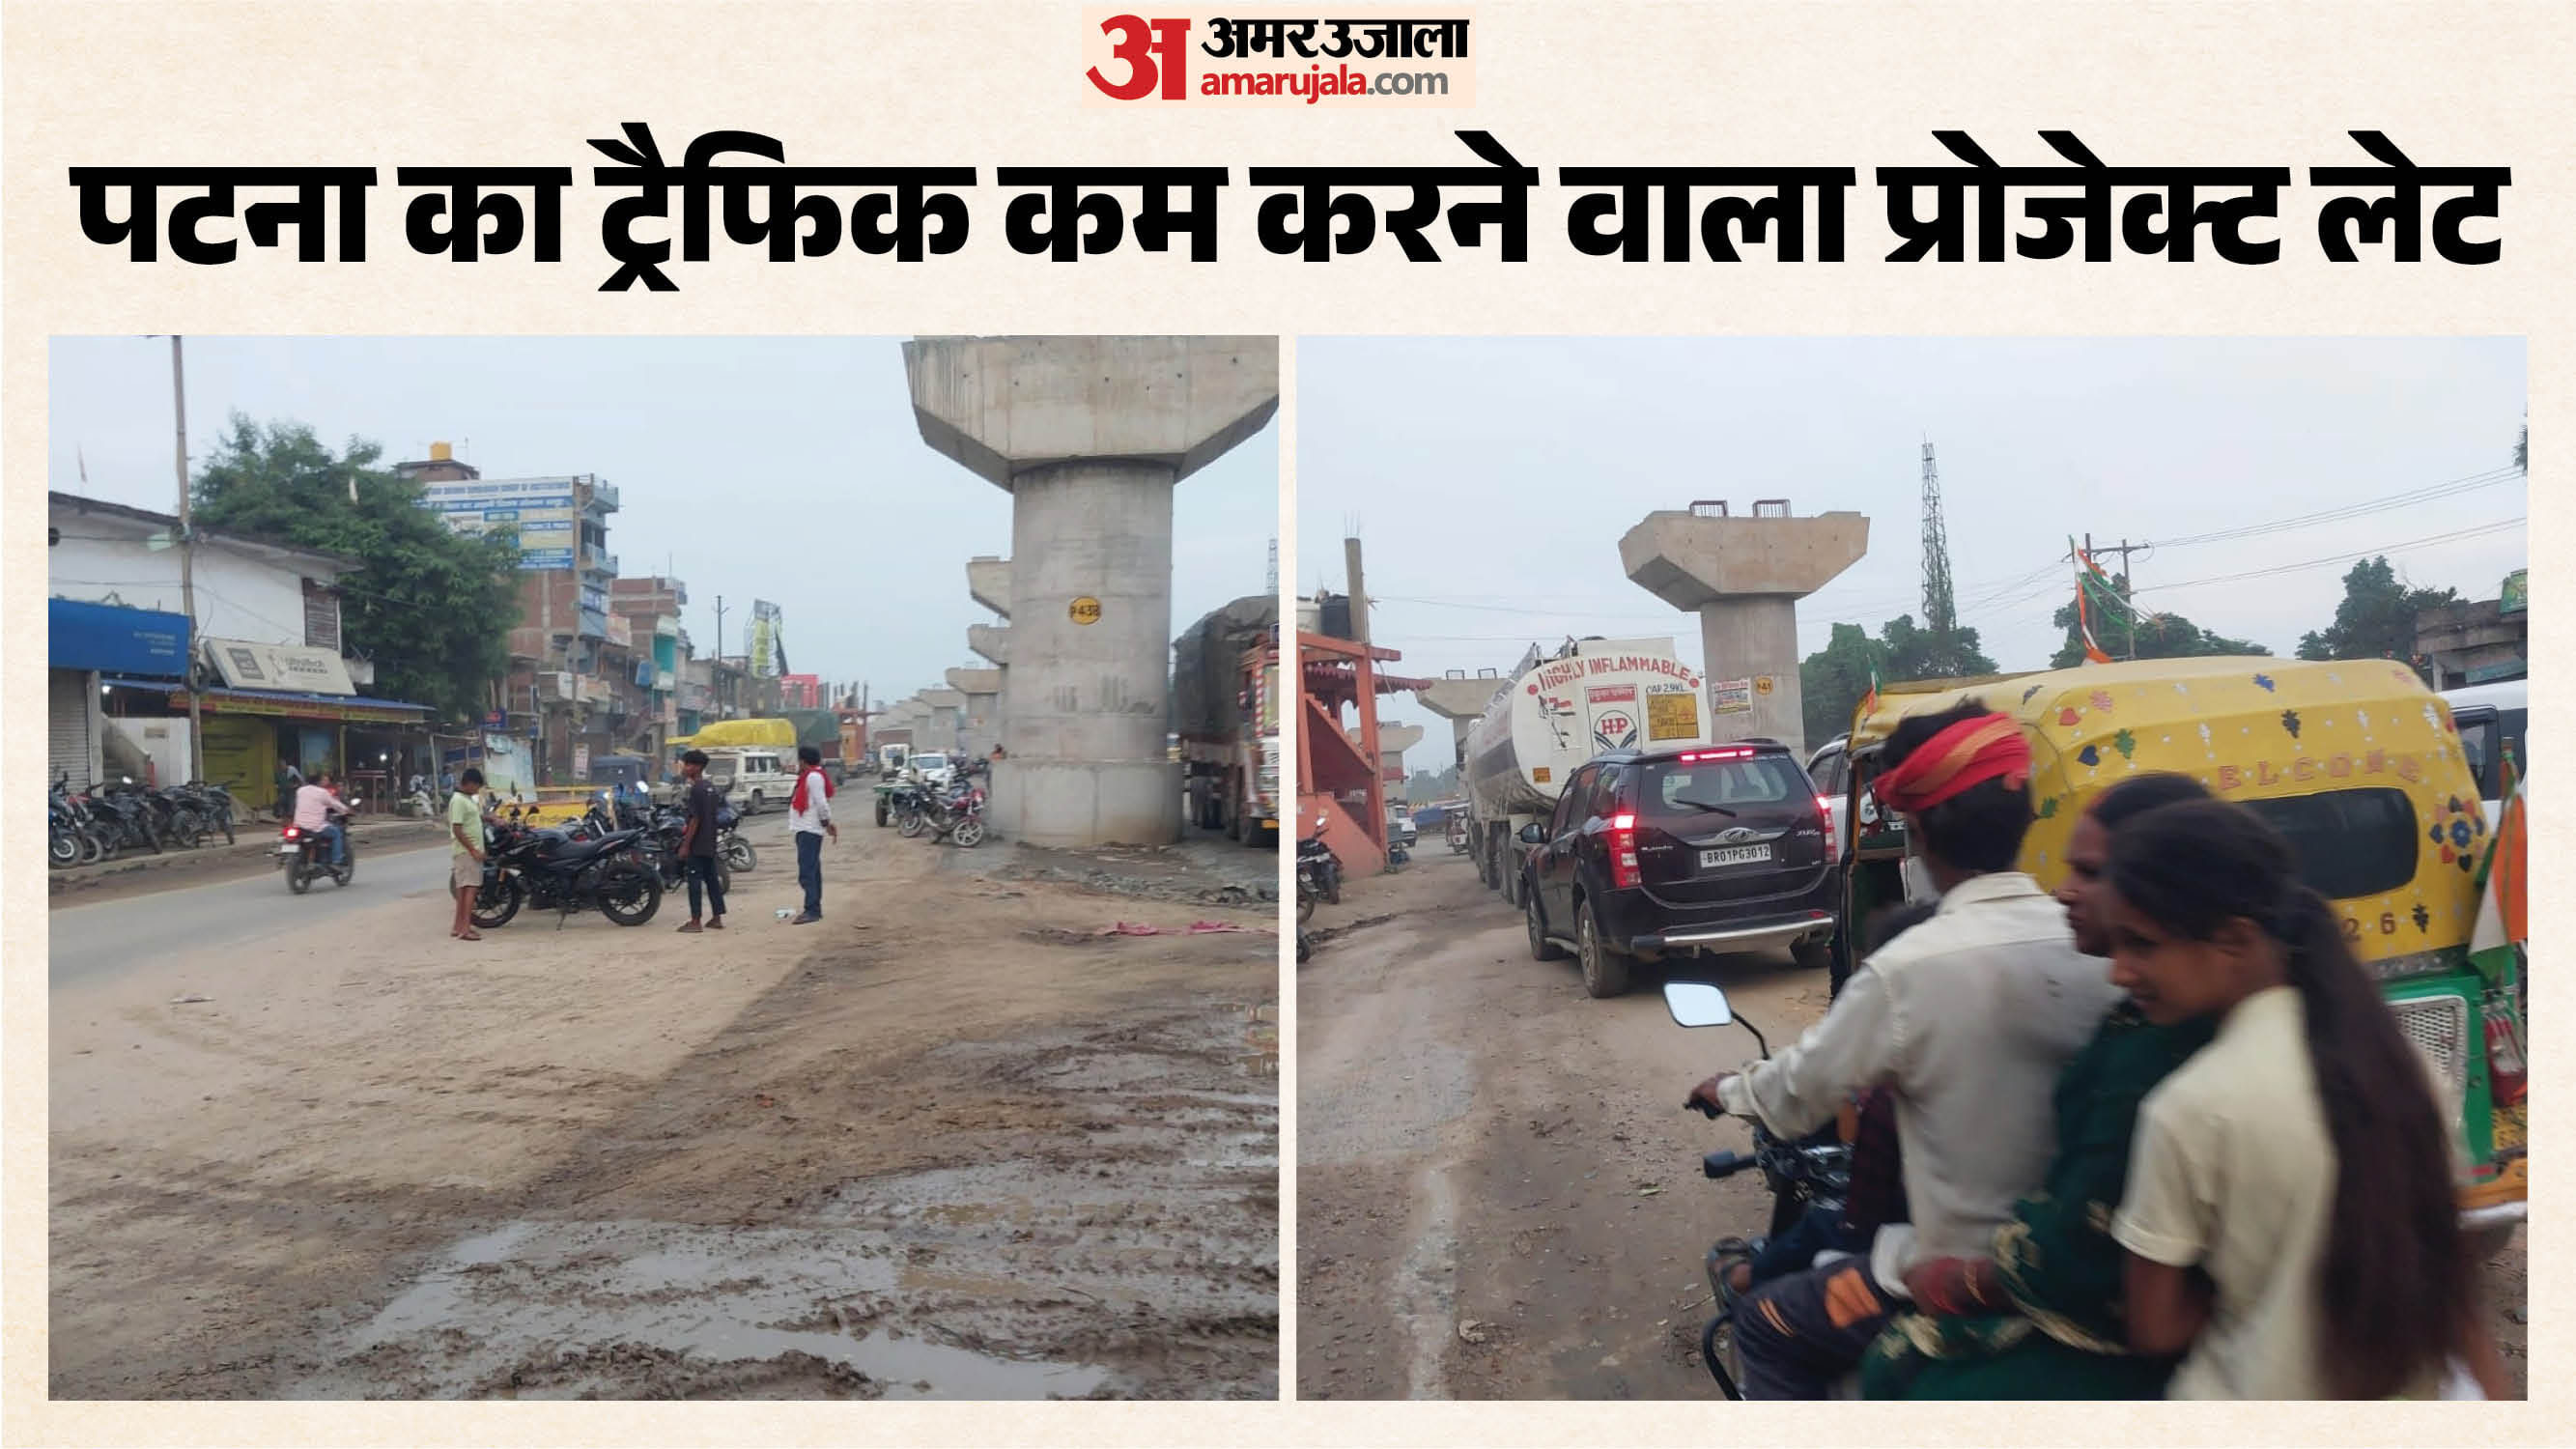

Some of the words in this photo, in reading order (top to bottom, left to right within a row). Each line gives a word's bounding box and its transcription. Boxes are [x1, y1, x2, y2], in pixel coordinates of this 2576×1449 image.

[1538, 659, 1585, 692] HIGHLY
[1589, 656, 1690, 681] INFLAMMABLE
[1600, 717, 1628, 735] HP
[2218, 749, 2420, 790] ELCOME
[1707, 845, 1770, 864] BR01PG3012
